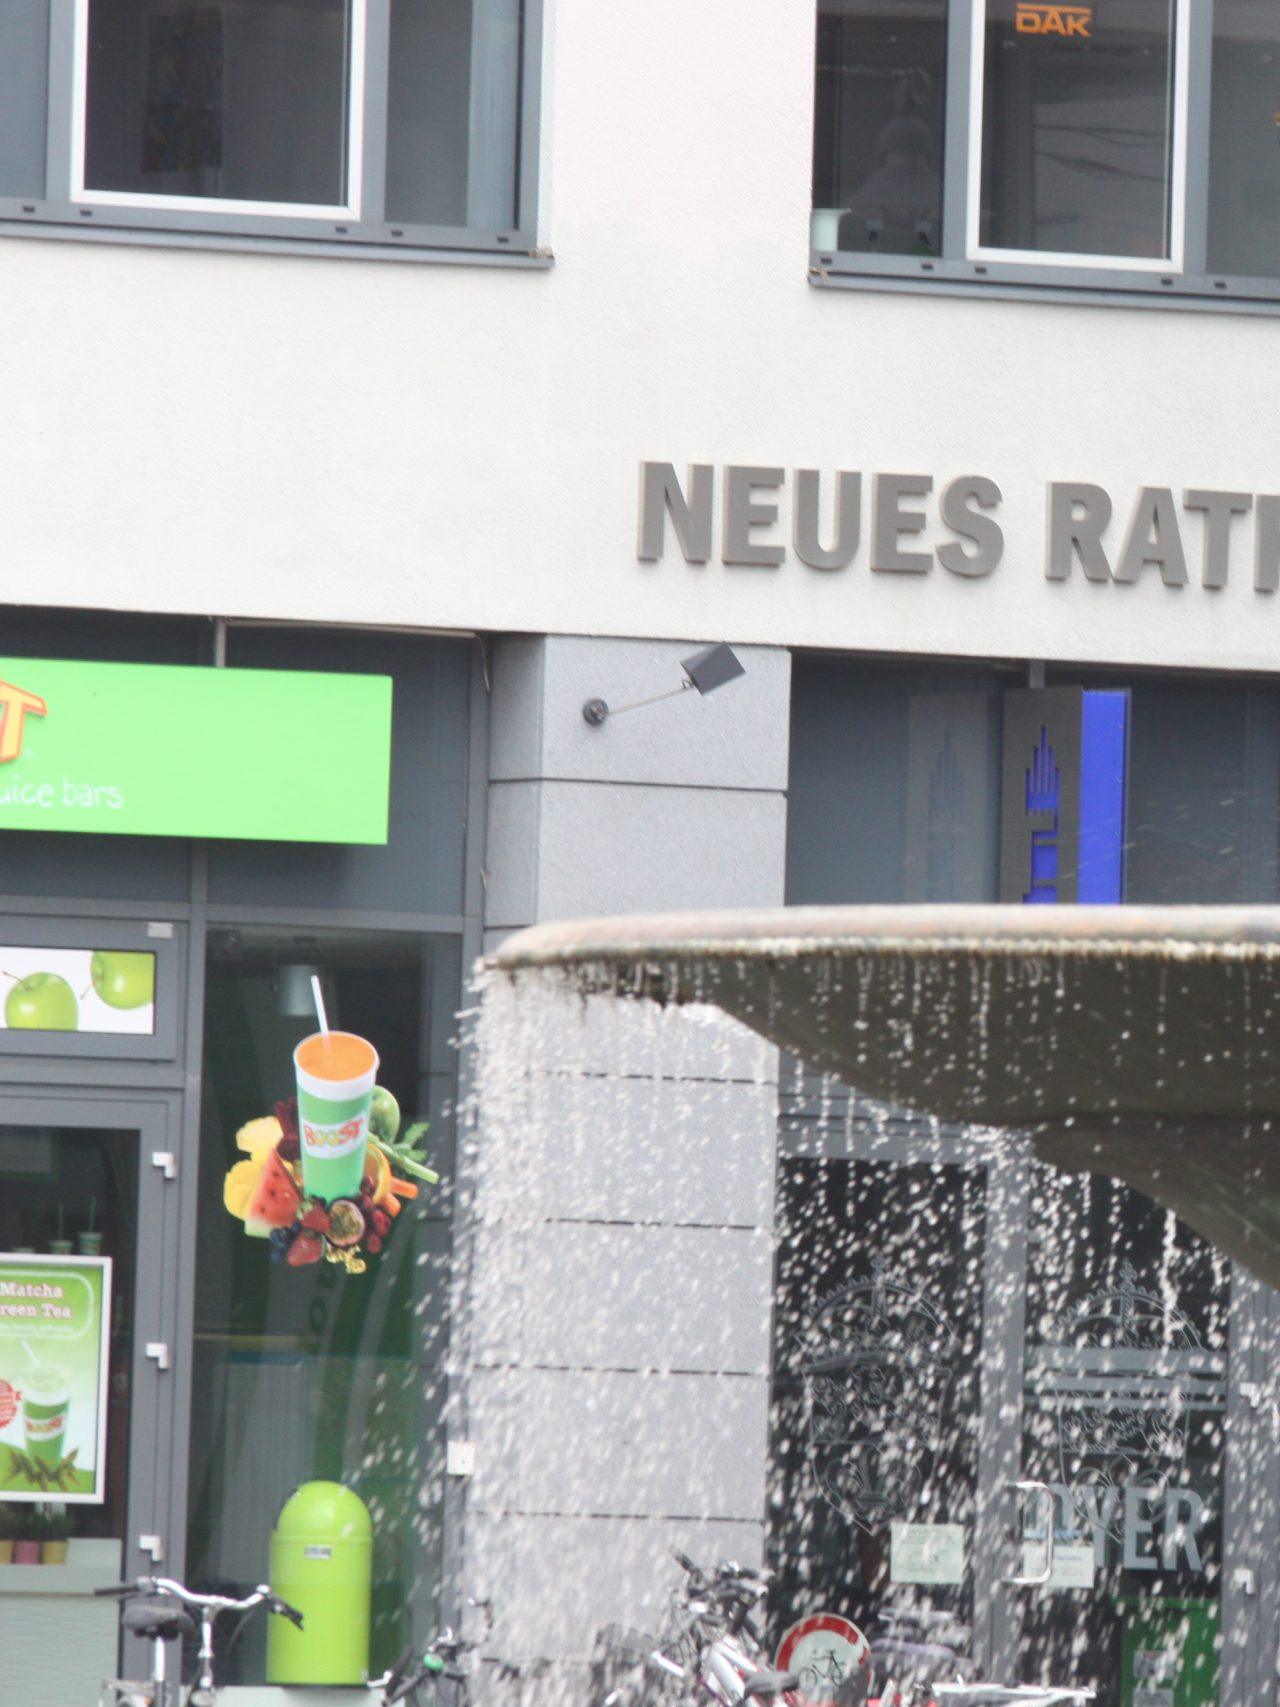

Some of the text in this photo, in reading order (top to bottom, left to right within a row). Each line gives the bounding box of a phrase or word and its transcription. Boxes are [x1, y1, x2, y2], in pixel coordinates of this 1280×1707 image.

[1015, 2, 1091, 37] DAK
[637, 460, 1004, 578] NEUES
[61, 776, 125, 809] bars
[40, 1303, 72, 1319] Tea
